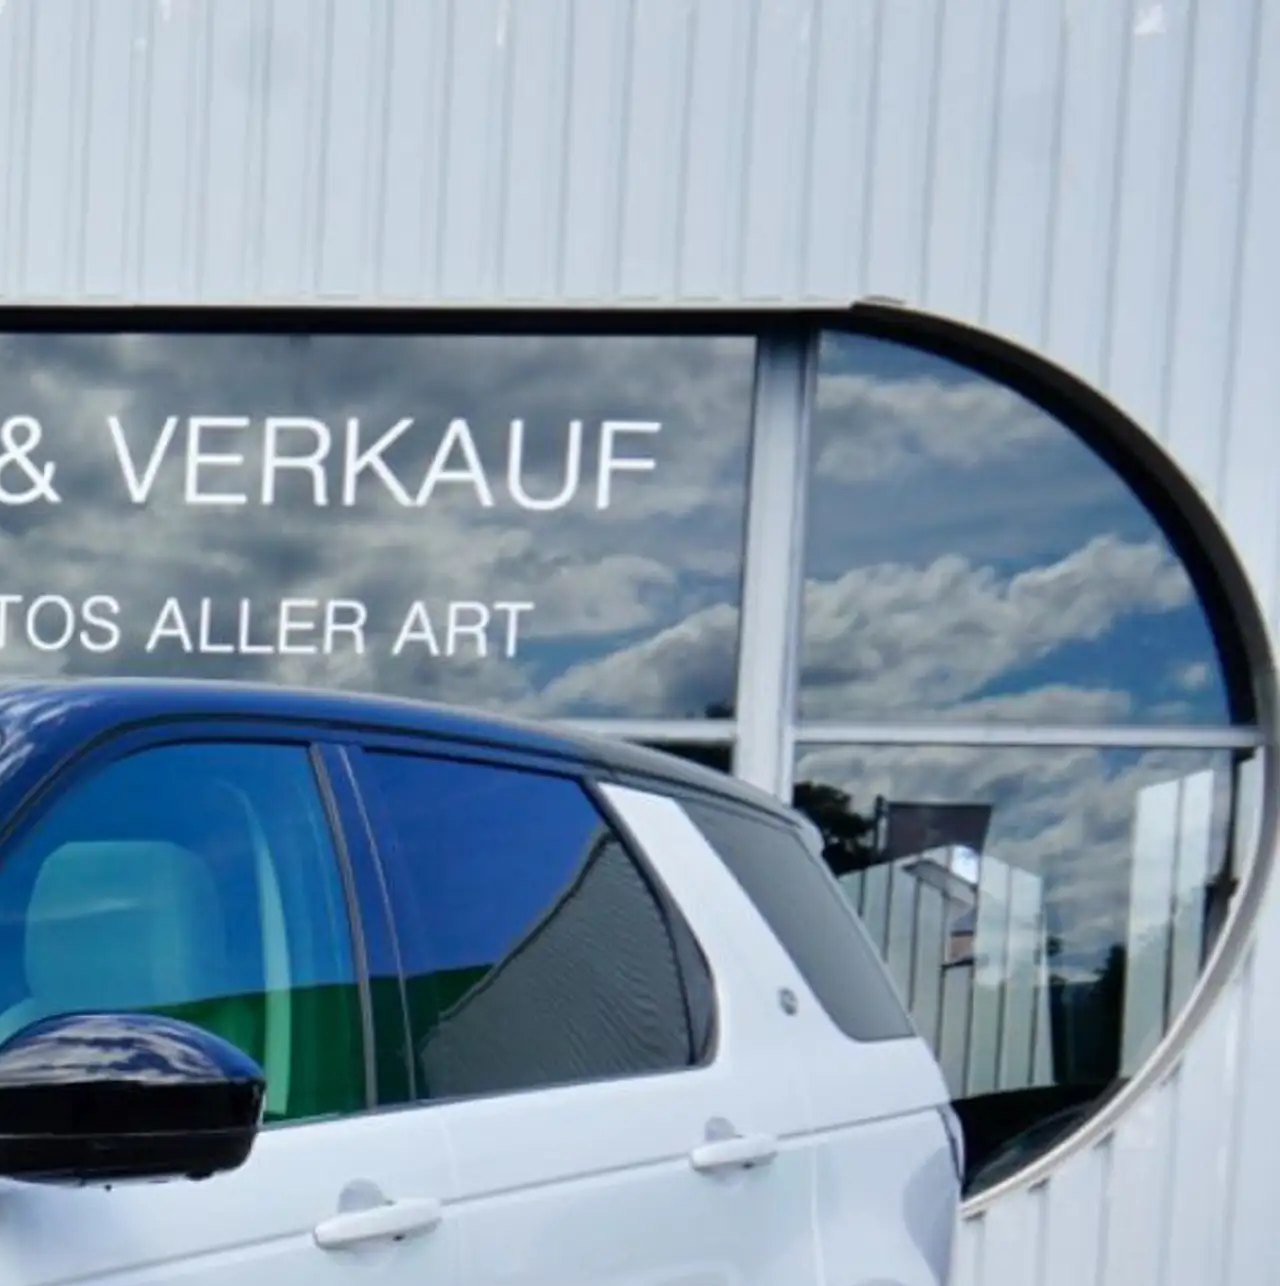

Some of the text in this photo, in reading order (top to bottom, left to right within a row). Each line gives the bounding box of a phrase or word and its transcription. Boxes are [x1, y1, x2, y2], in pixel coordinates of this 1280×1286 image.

[107, 415, 662, 511] VERKAUF
[145, 597, 367, 656] ALLER
[392, 600, 535, 658] ART
